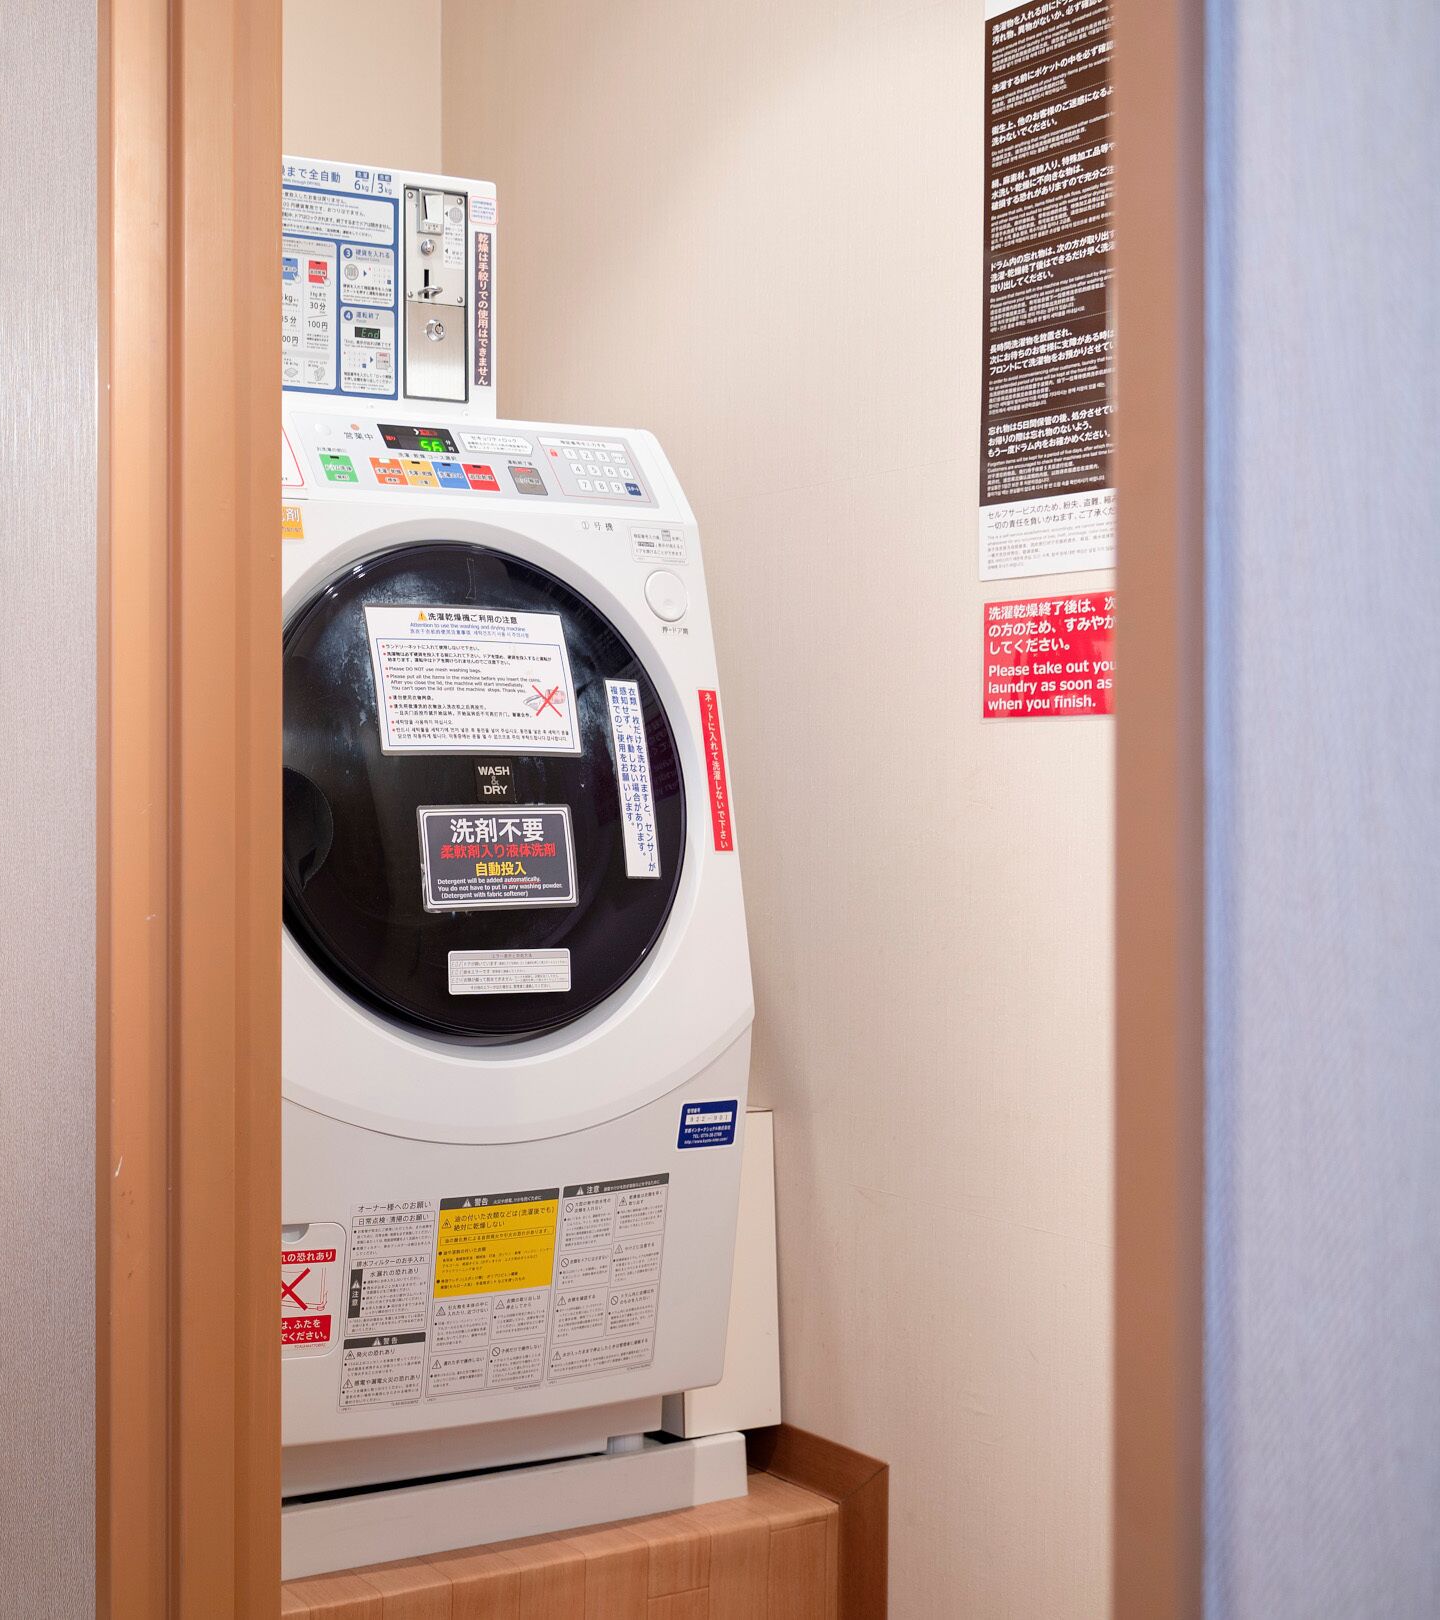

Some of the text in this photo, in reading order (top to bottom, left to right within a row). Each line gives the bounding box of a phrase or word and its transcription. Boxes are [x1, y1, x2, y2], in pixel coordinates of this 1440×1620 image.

[991, 271, 1054, 293] 取り出してください。
[308, 321, 328, 330] 100円
[361, 329, 379, 338] End
[344, 432, 373, 440] 営業中
[420, 439, 443, 452] 56
[989, 596, 1115, 620] 洗濯乾燥終了後は、次
[428, 613, 518, 624] 洗濯乾燥機ご利用の注意
[989, 615, 1116, 637] の方のため、すみやか
[990, 638, 1070, 654] してください。
[989, 665, 1029, 676] Please
[1033, 661, 1062, 674] take
[1066, 660, 1089, 672] out
[989, 679, 1112, 694] laundry as soon as
[988, 695, 1096, 711] when you finish.
[610, 686, 634, 826] 複数でのご使用をお願いします。
[478, 766, 509, 775] WASH
[619, 687, 646, 856] 感知せず、作動しない場合があります。
[705, 692, 728, 848] ネットに入れて洗濯しないで下さい
[491, 776, 499, 785] &
[628, 688, 656, 871] 衣類一枚だけを洗われますと、センサーが
[484, 786, 507, 794] DRY
[450, 818, 544, 843] 洗剤不要
[440, 843, 556, 859] 柔軟剤入り液体洗剤
[476, 862, 526, 876] 自動投入
[587, 1186, 599, 1194] 注意
[358, 1201, 431, 1213] オーナー様へのお願い
[475, 1197, 488, 1206] 警告
[453, 1220, 505, 1231] 絶対に乾燥しない
